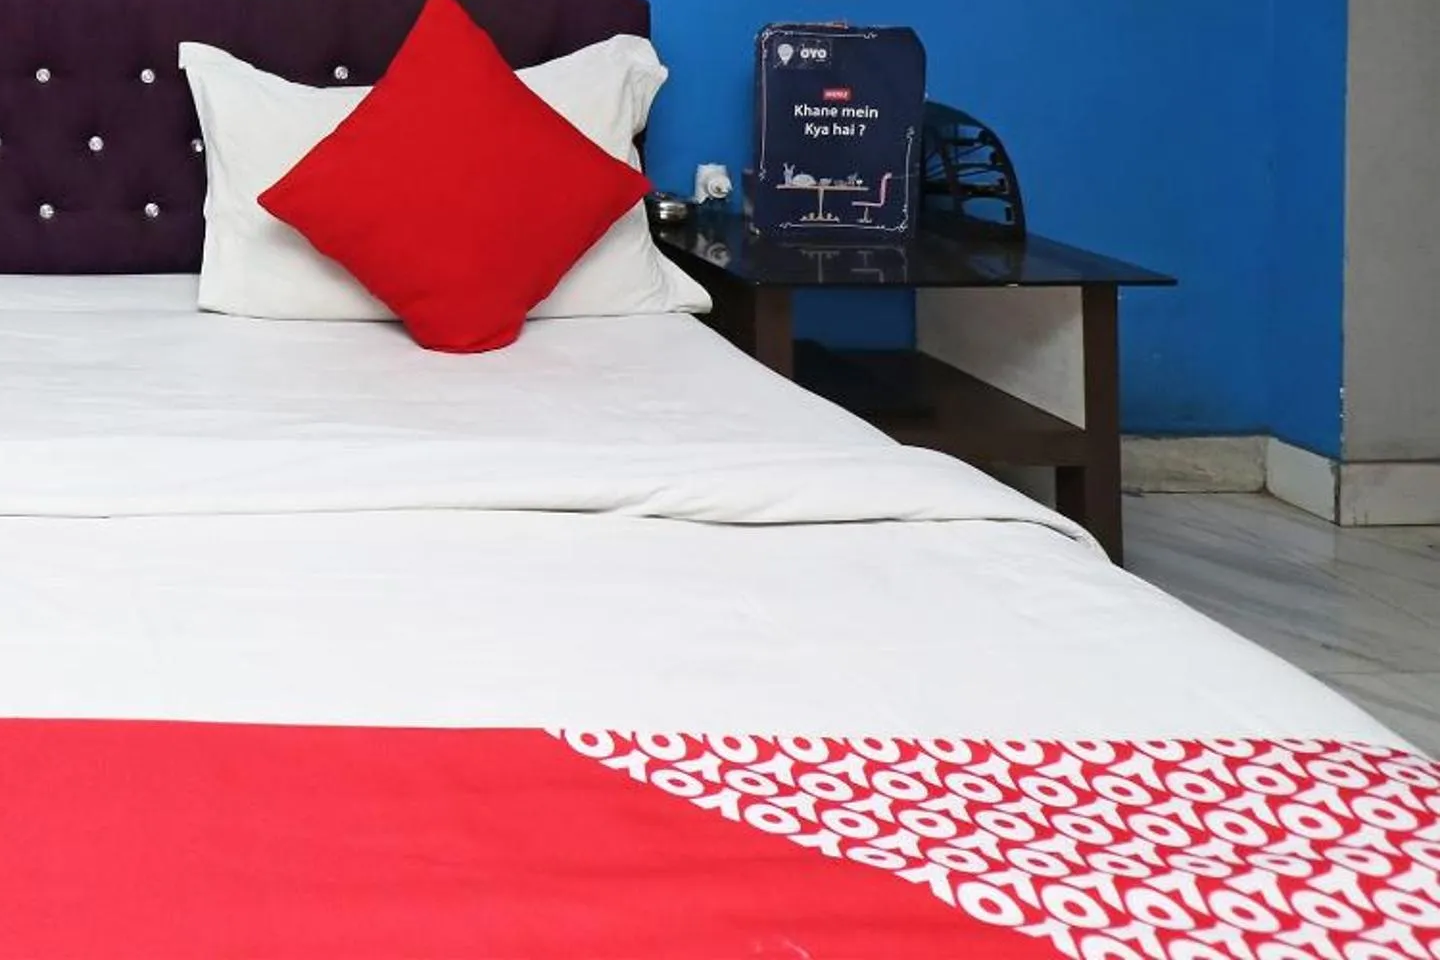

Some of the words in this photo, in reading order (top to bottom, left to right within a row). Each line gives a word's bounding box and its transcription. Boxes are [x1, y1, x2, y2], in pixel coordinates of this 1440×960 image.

[794, 104, 838, 118] Khane
[841, 105, 879, 119] mein
[804, 122, 830, 139] Kya
[832, 122, 855, 136] hai
[858, 124, 866, 137] ?
